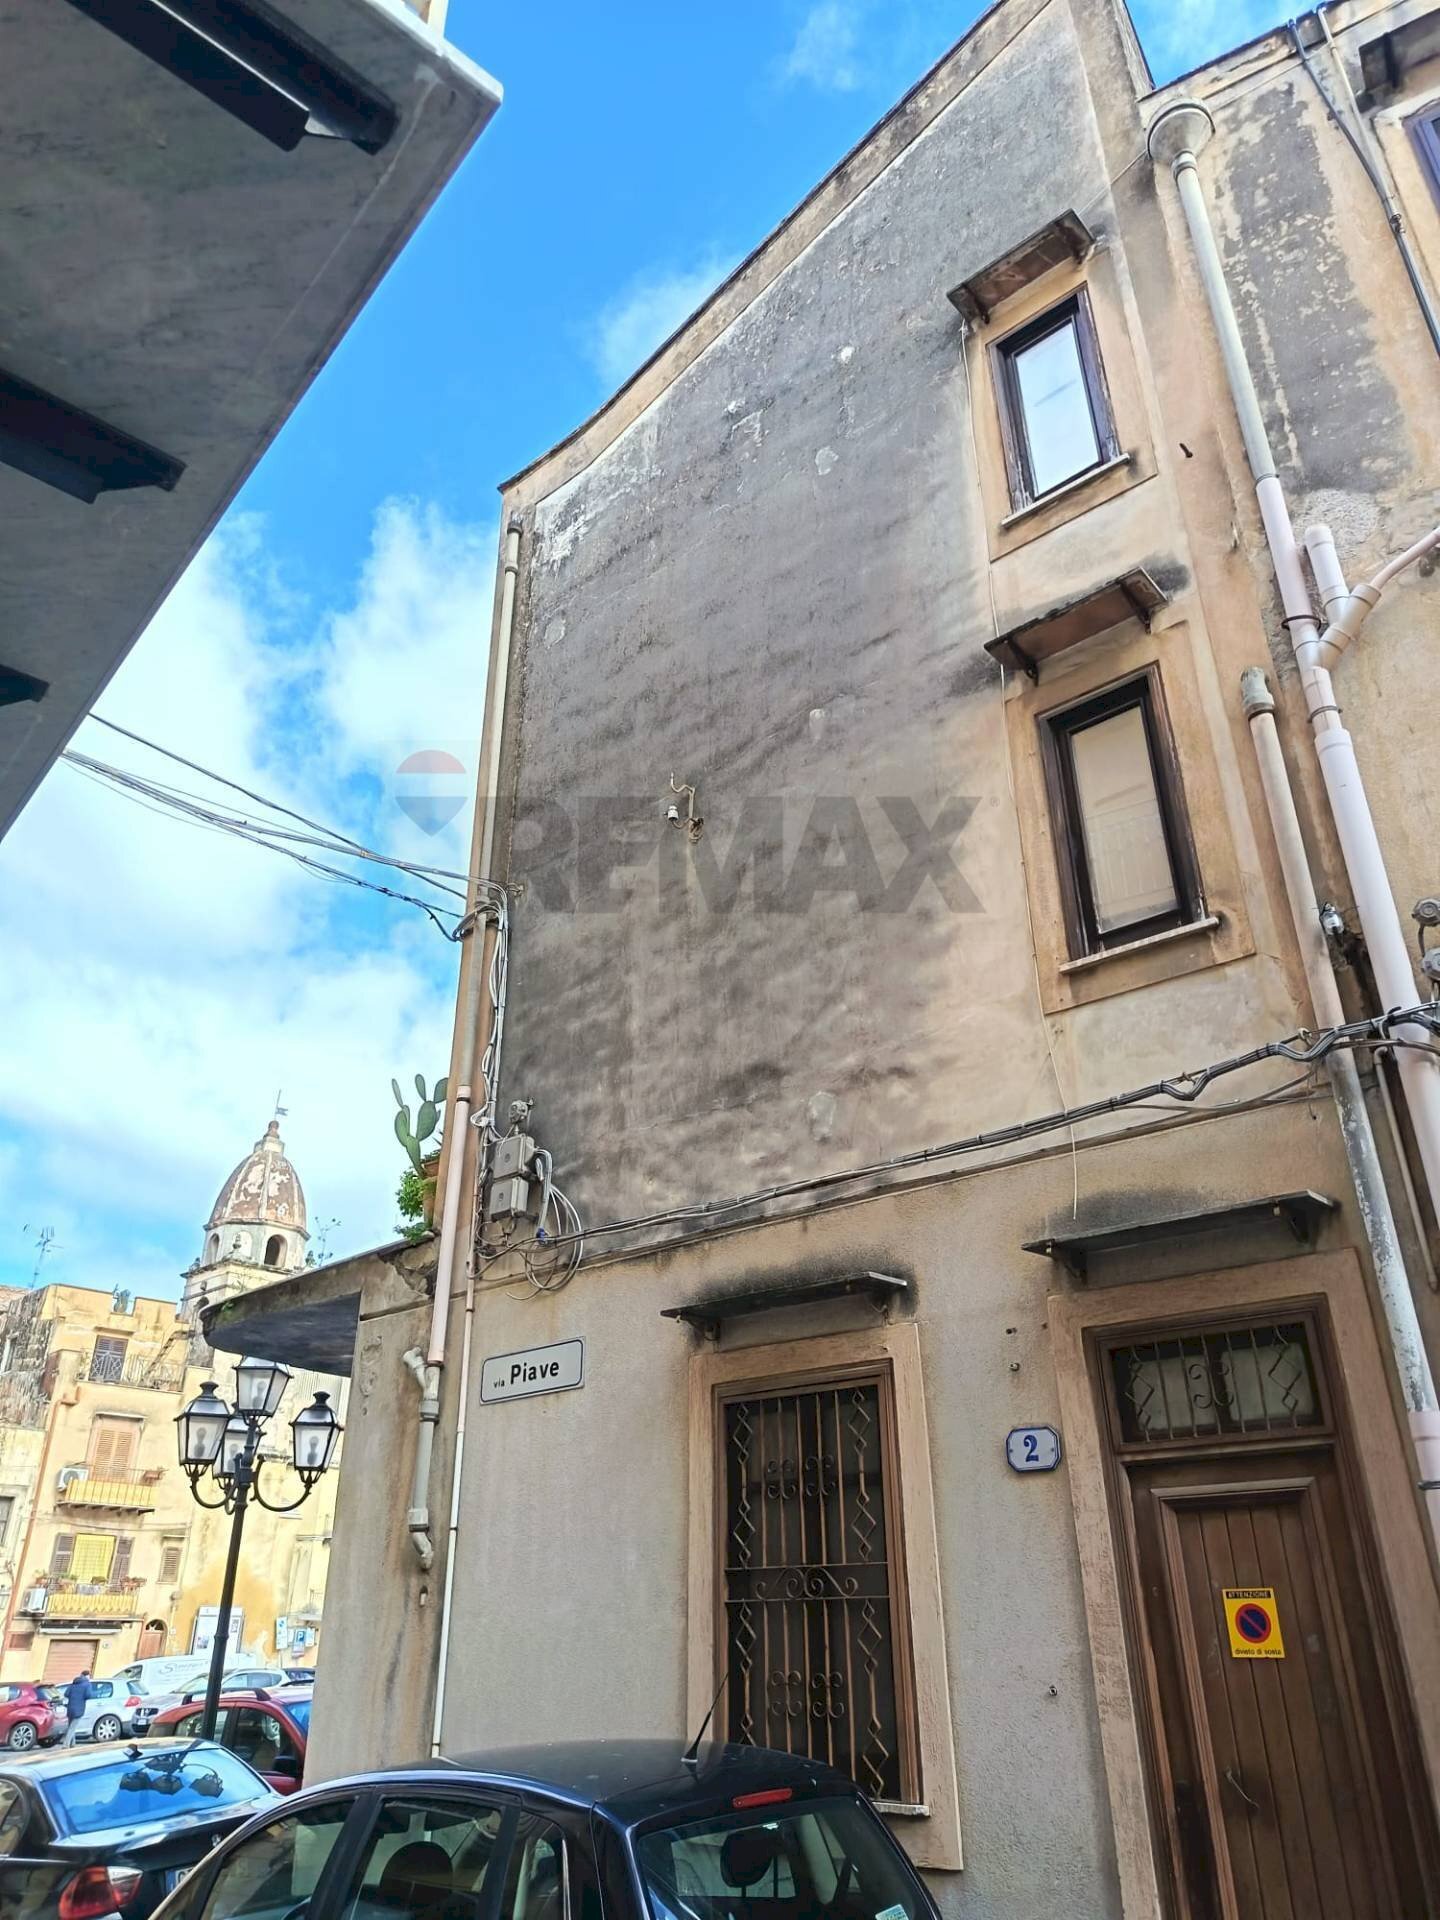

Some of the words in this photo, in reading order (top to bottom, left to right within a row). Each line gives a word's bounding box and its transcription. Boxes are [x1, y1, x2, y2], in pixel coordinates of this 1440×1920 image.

[493, 1377, 505, 1388] via
[510, 1361, 560, 1385] Piave
[1023, 1434, 1039, 1462] 2
[1228, 1591, 1269, 1599] ATTENZIONE
